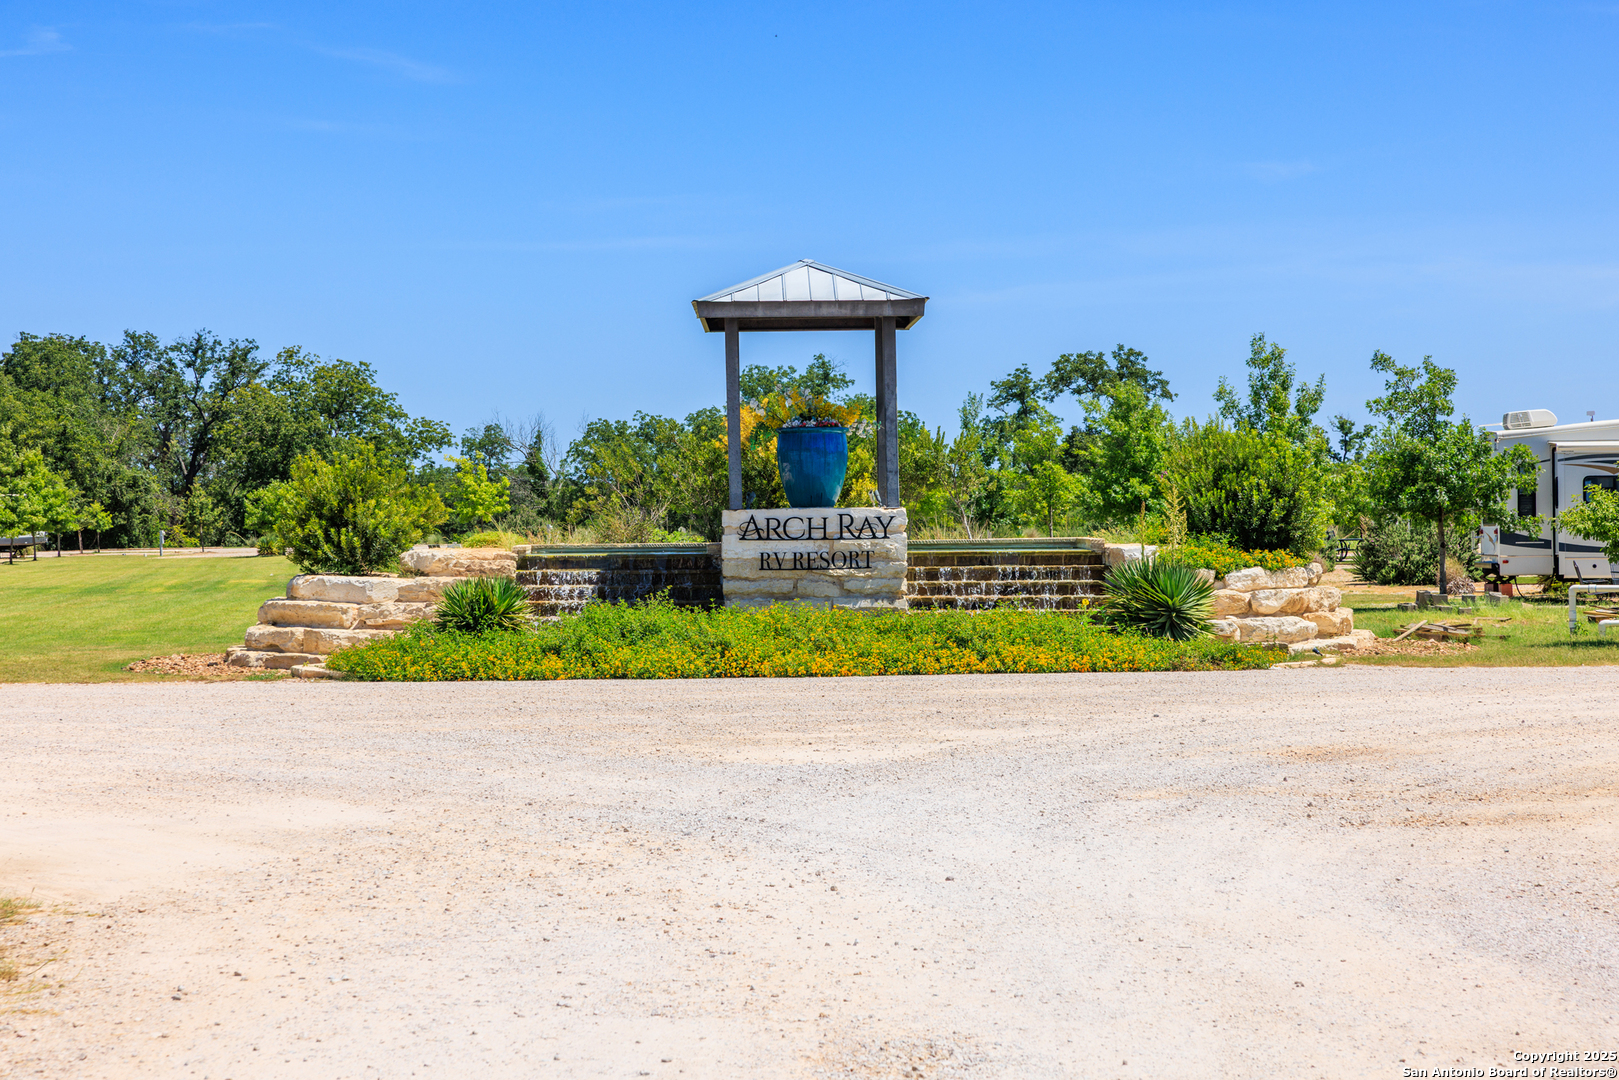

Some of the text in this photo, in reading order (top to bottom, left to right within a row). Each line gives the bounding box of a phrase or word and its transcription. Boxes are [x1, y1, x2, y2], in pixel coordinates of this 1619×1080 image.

[737, 513, 896, 541] ARCH RAY
[759, 550, 875, 570] RV RESORT
